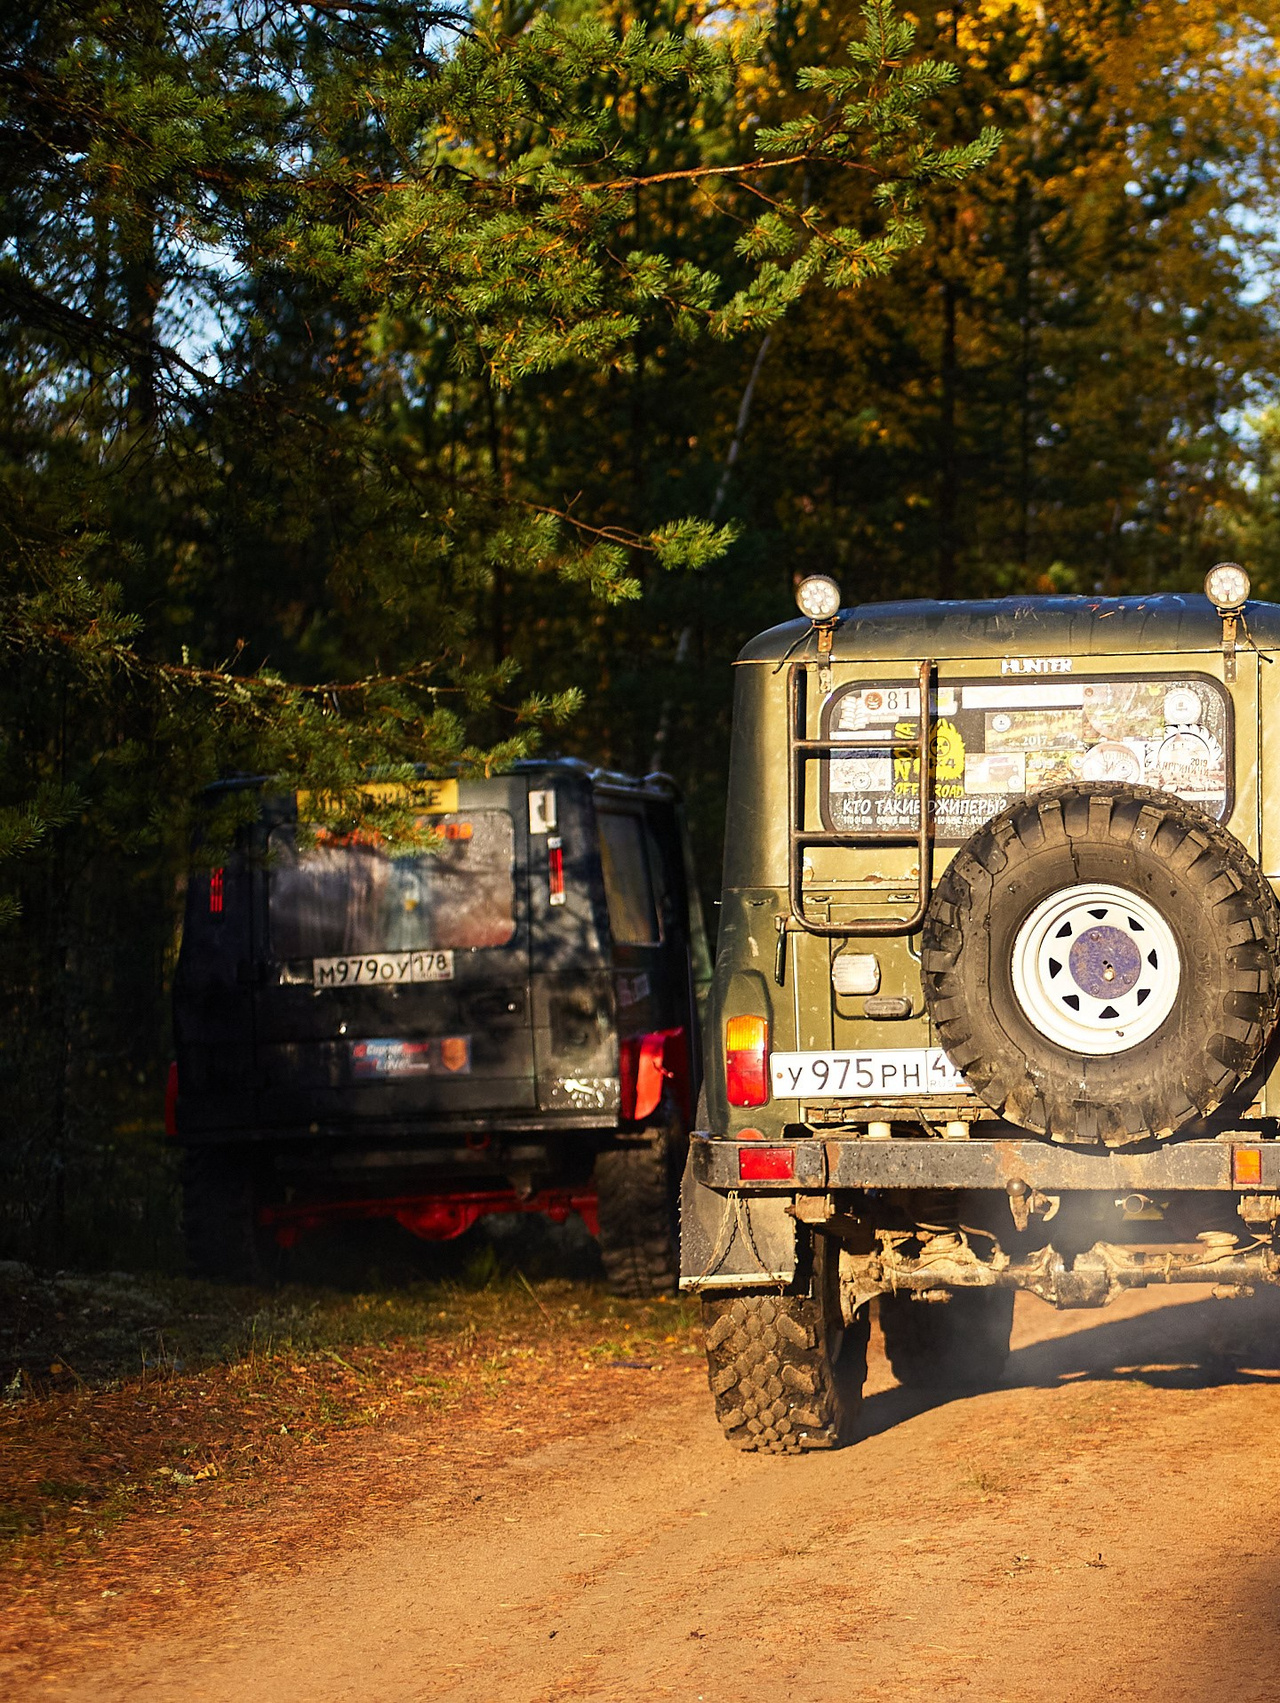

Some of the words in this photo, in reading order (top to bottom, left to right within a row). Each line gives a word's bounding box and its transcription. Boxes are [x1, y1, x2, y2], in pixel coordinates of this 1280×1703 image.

[1001, 658, 1072, 674] HUNTER
[887, 691, 911, 710] 81
[1190, 758, 1208, 768] 2019
[895, 782, 919, 796] OFF
[843, 799, 872, 815] КТО
[875, 798, 921, 815] ТАКИЕ
[413, 954, 447, 972] 178
